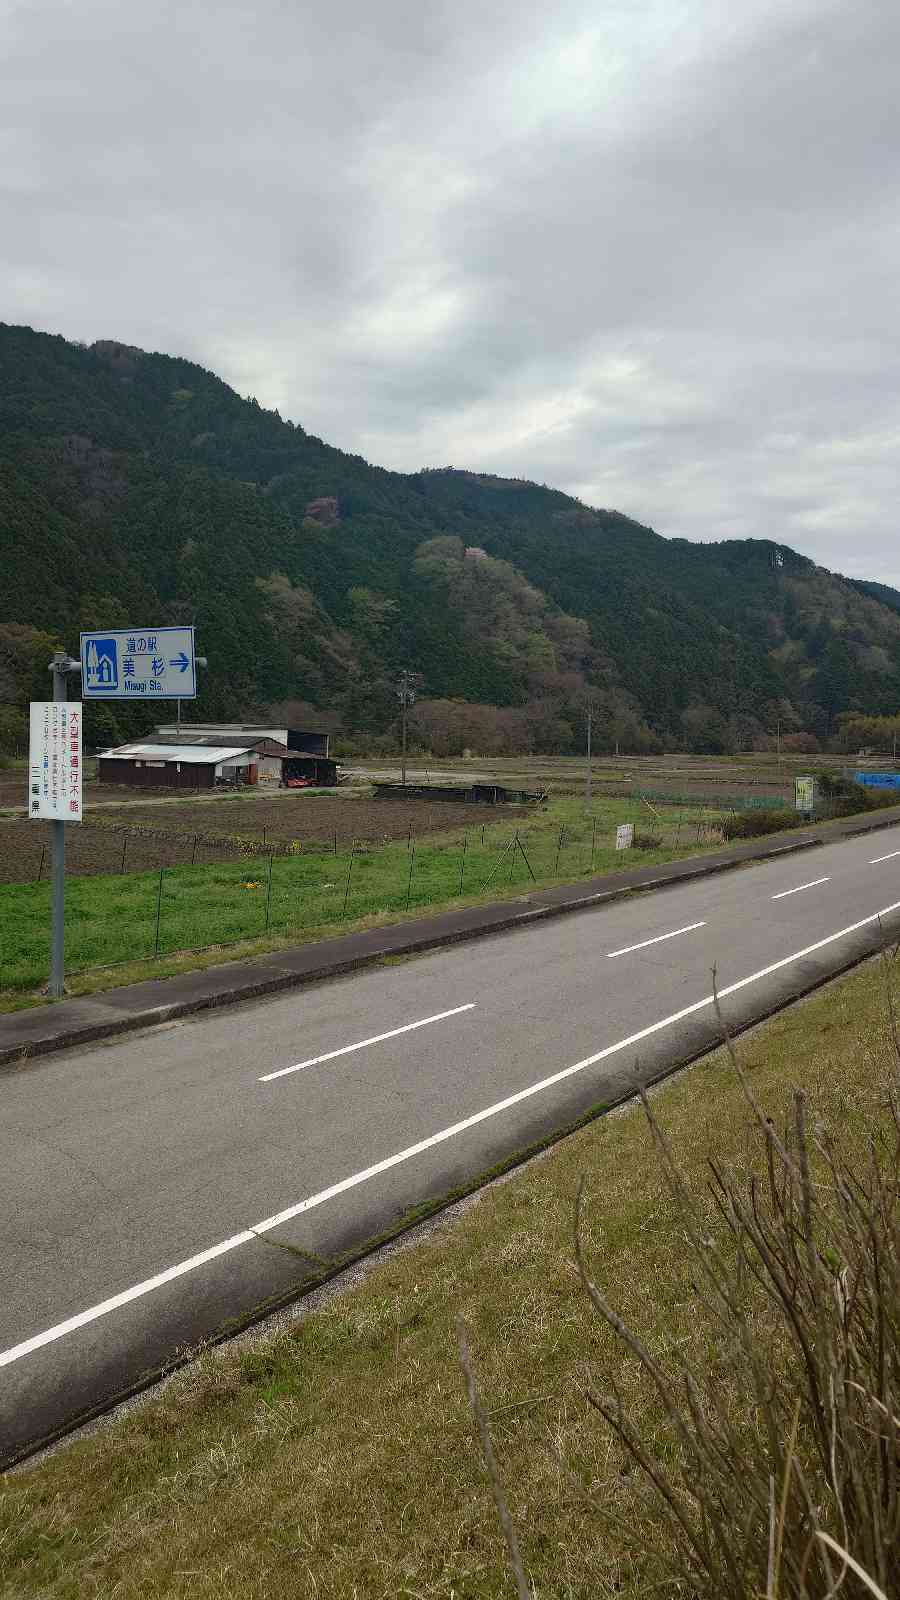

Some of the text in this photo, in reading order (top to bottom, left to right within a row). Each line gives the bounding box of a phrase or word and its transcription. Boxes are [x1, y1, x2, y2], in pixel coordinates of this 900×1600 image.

[126, 636, 157, 653] 道の駅
[124, 680, 164, 693] Misugi Sta.
[69, 711, 80, 813] 大型車通行不能
[31, 766, 41, 816] 三重県
